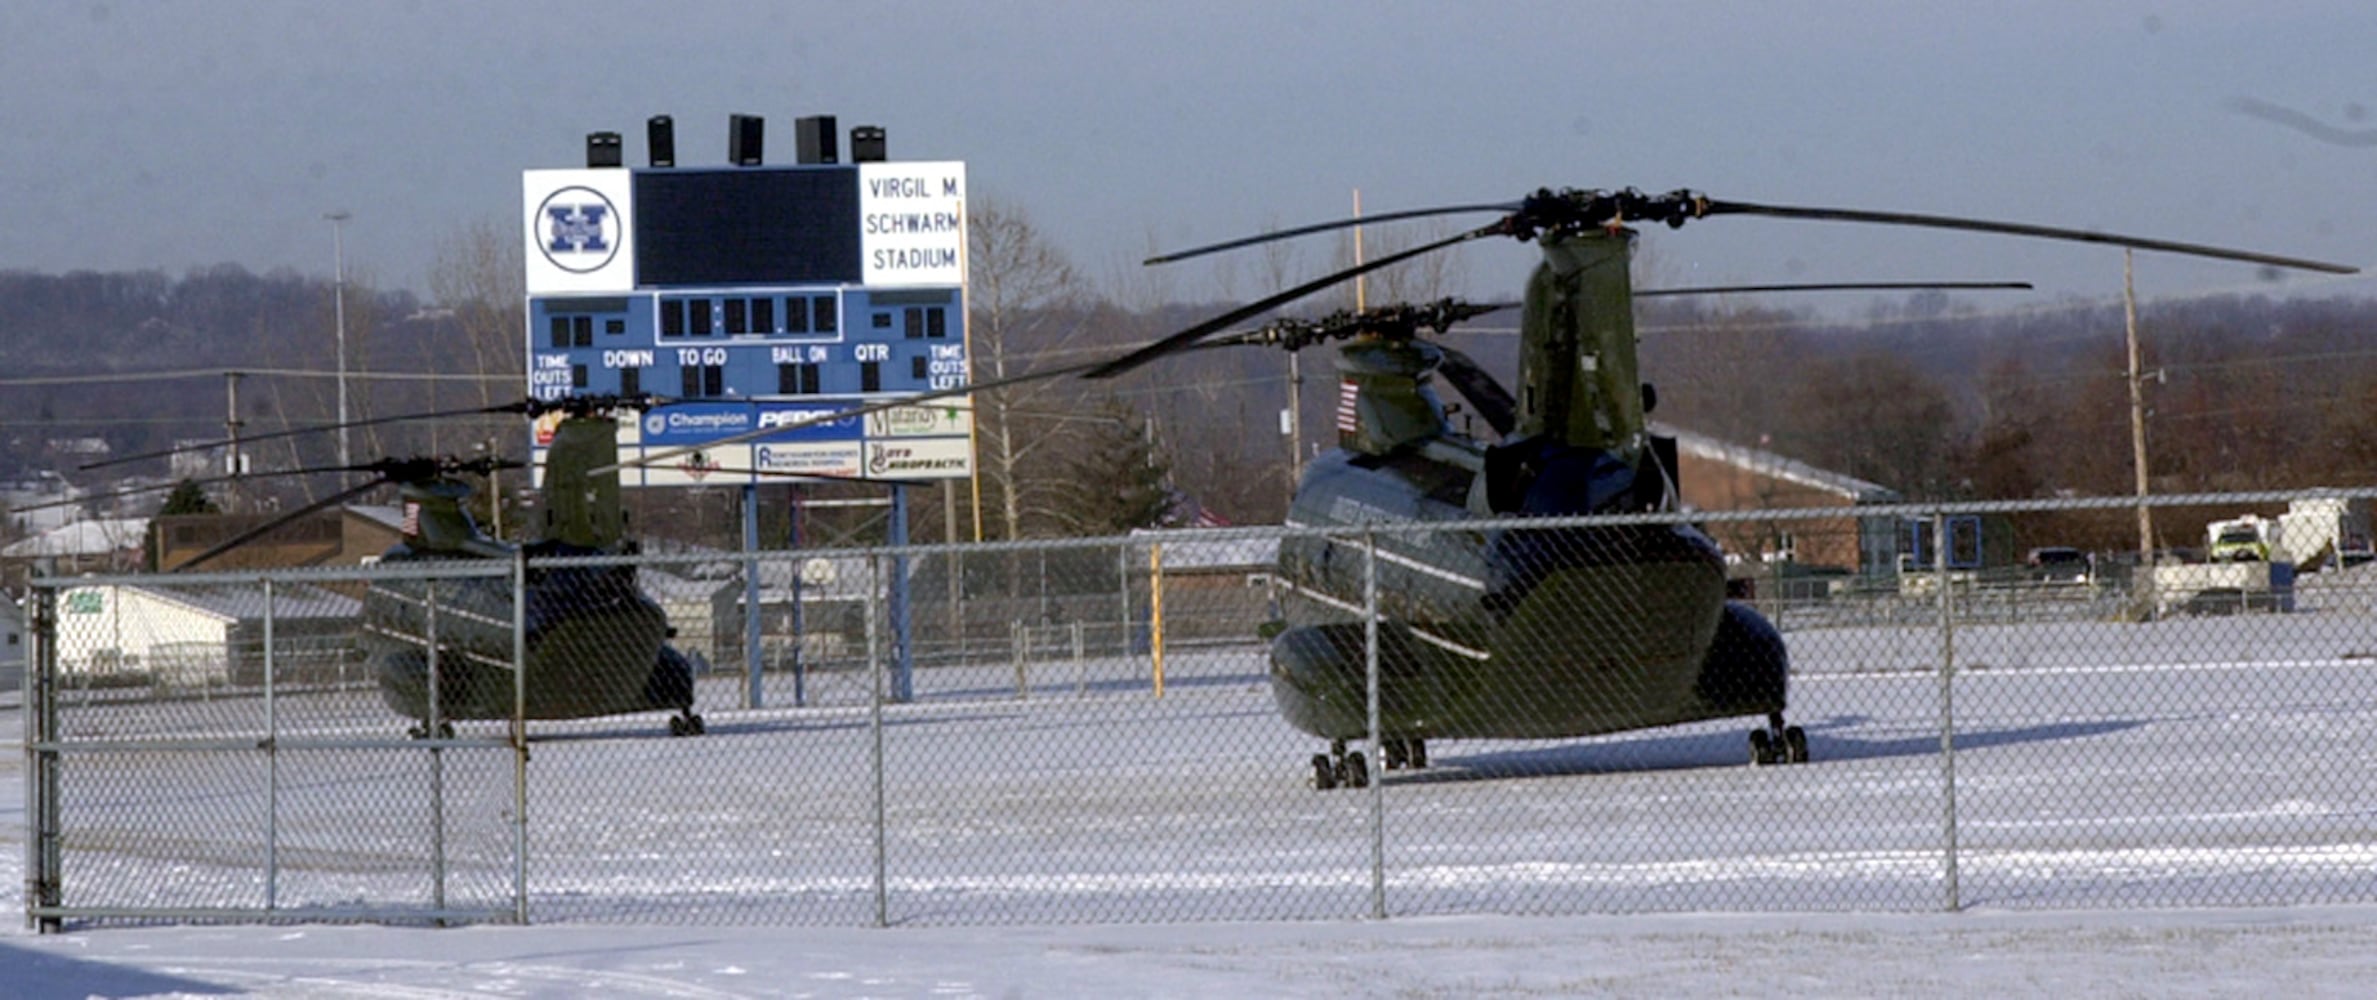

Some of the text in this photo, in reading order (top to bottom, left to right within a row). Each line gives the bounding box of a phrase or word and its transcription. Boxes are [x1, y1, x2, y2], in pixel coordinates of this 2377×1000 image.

[869, 177, 931, 198] VIRGIL
[866, 212, 960, 234] SCHWARM
[873, 247, 956, 270] STADIUM
[603, 350, 653, 368] DOWN
[678, 348, 727, 367] TO GO
[772, 346, 827, 363] BALL ON
[855, 344, 889, 361] QTR
[930, 344, 962, 360] TIME
[537, 353, 571, 369] TIME
[930, 360, 967, 374] OUTS
[534, 369, 572, 385] OUTS
[930, 374, 965, 390] LEFT
[669, 411, 749, 428] Champion
